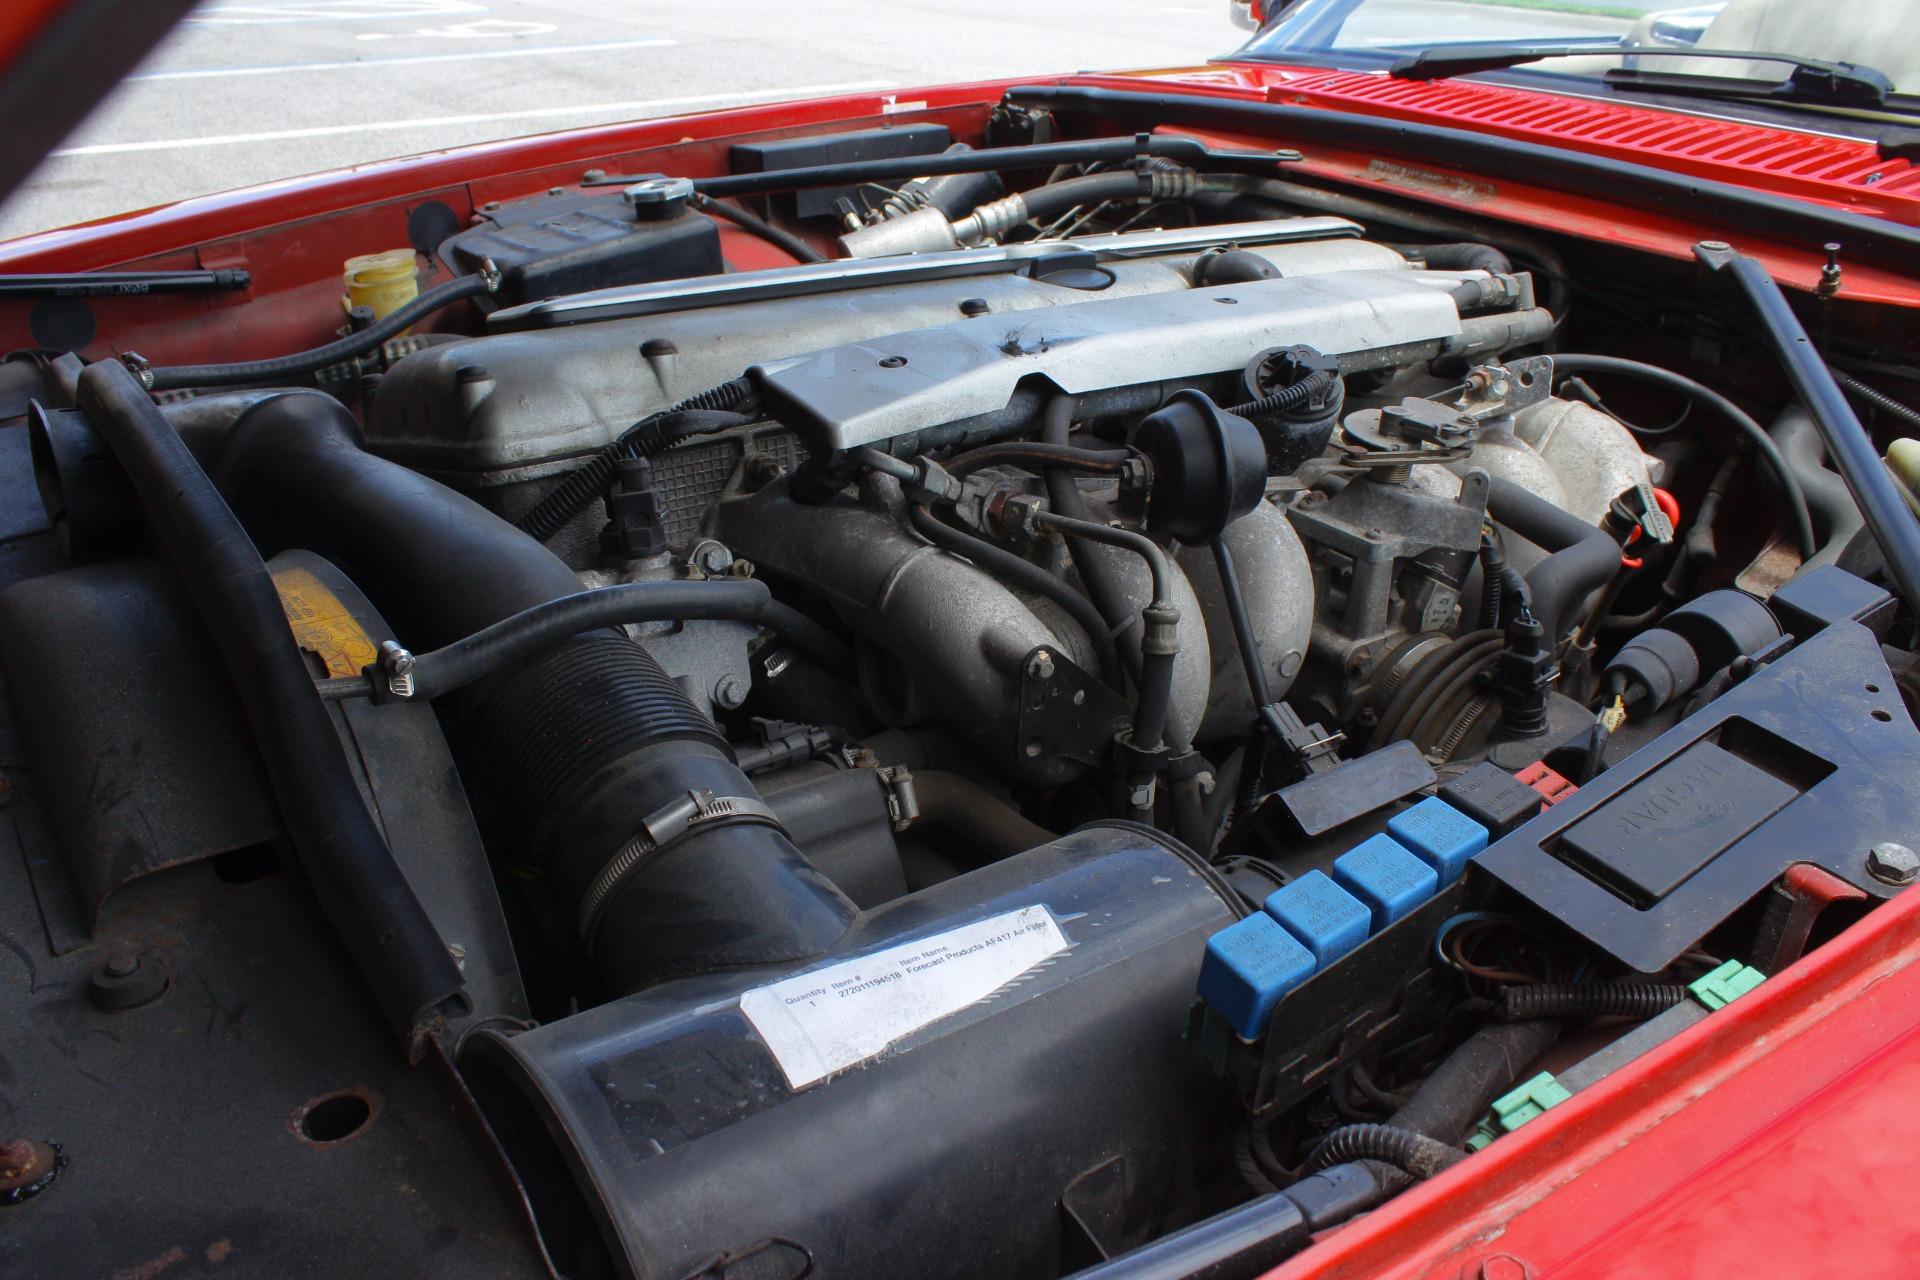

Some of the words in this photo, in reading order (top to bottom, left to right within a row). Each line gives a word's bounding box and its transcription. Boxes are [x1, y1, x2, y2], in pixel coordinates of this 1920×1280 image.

[784, 986, 827, 1005] Quantity
[831, 978, 854, 990] Item
[898, 953, 921, 967] Item
[921, 944, 949, 959] Name
[809, 1000, 816, 1008] 1
[839, 970, 902, 998] 272011194518
[906, 956, 946, 975] Forecast
[946, 943, 984, 961] Products
[985, 931, 1012, 948] AF417
[1013, 926, 1027, 937] Air
